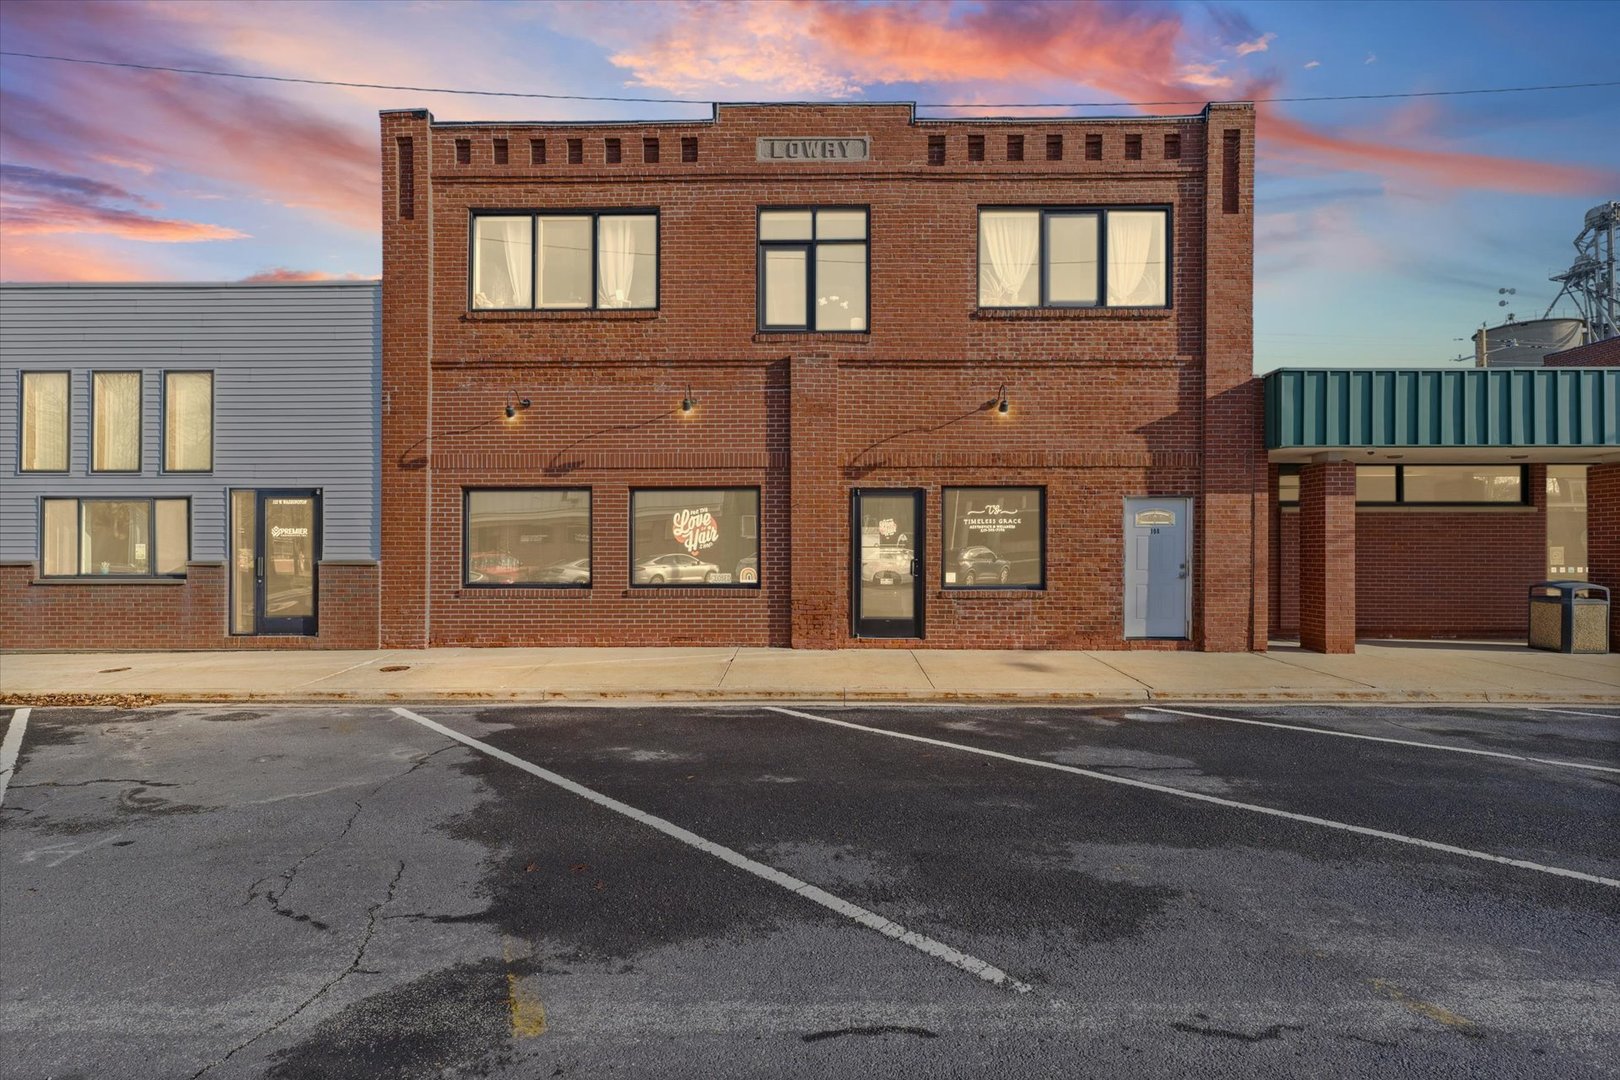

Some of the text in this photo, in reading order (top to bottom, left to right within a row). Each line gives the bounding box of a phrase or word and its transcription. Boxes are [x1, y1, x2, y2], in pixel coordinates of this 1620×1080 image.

[769, 140, 849, 159] LOWRY
[280, 527, 308, 535] PREMIER
[673, 509, 712, 537] Love
[684, 525, 719, 552] Hair
